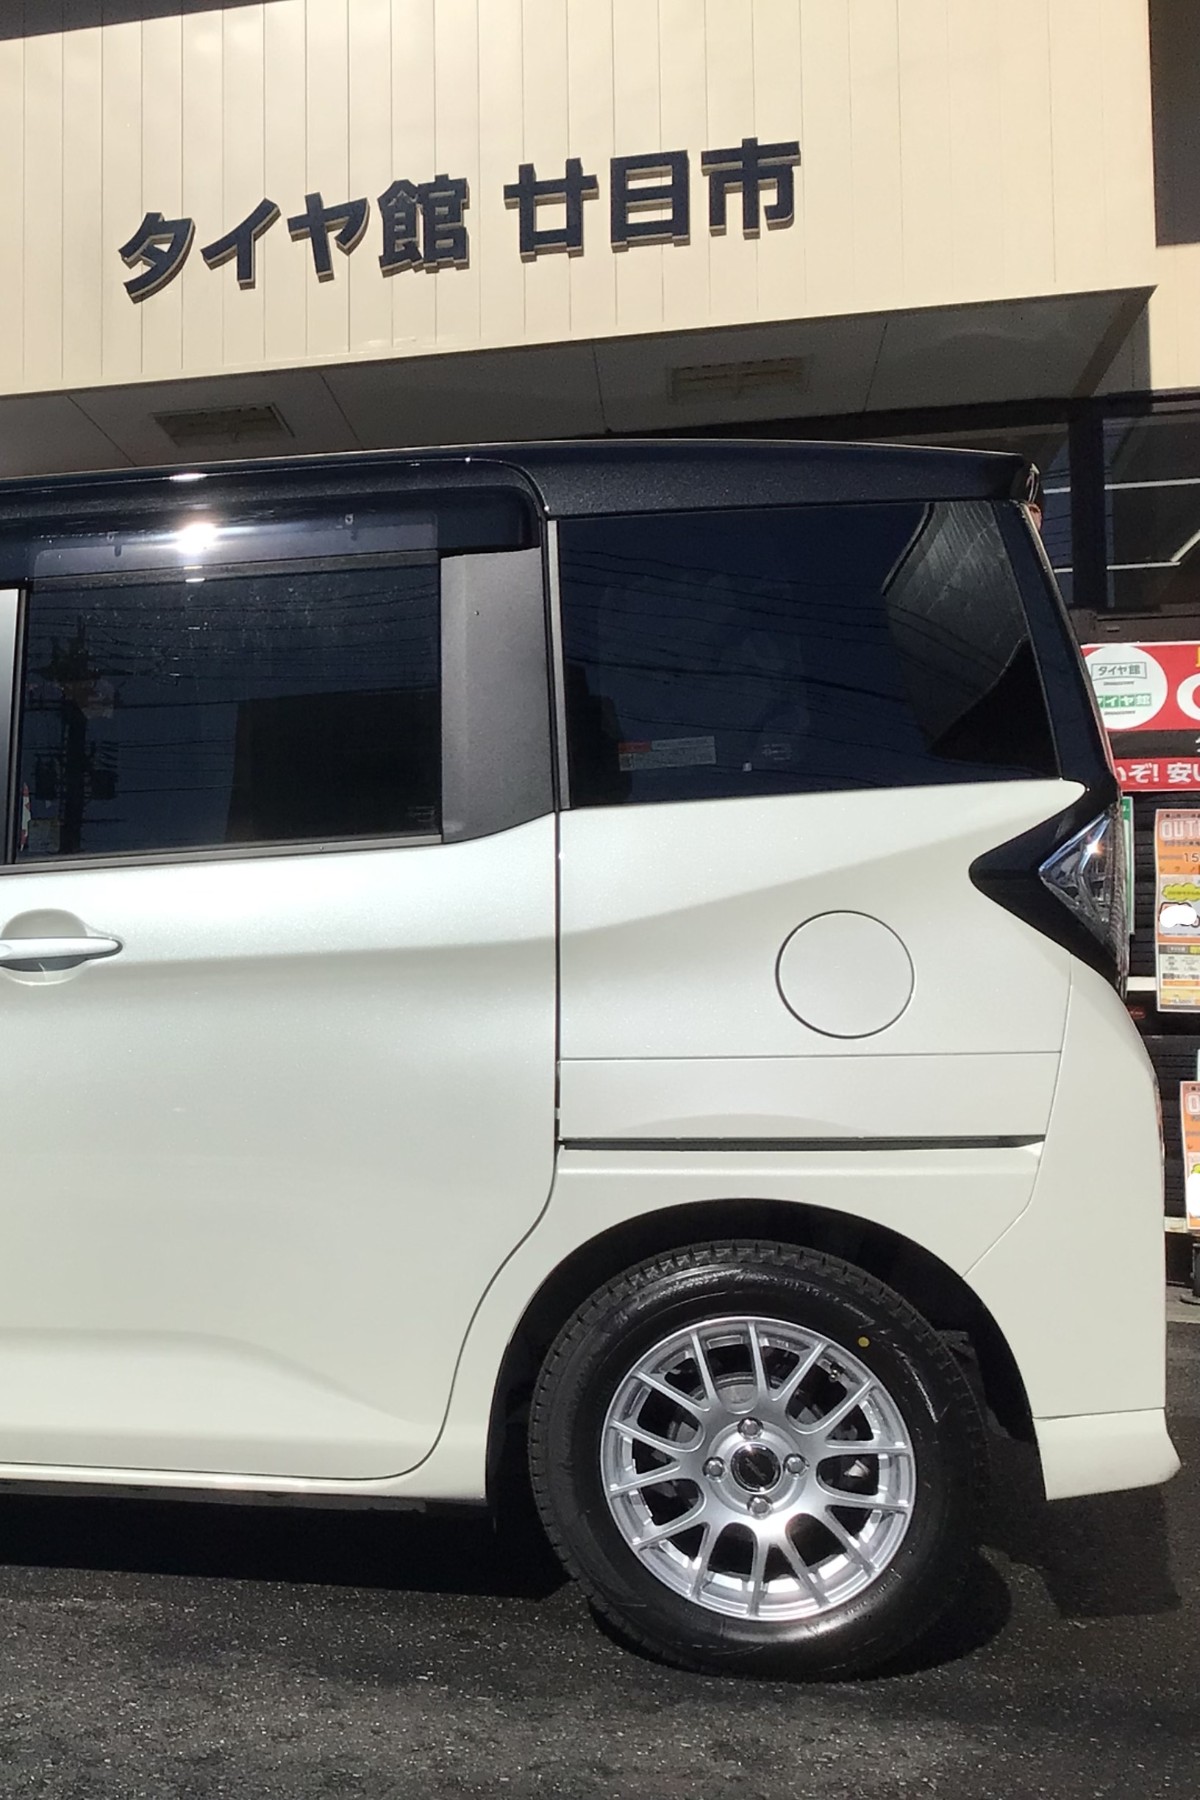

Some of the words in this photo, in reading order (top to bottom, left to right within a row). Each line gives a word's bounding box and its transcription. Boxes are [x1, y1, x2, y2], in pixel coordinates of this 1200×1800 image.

[118, 174, 470, 304] タイヤ館
[503, 136, 801, 263] 廿日市
[1097, 663, 1142, 677] タイヤ館
[1161, 820, 1200, 839] OUT
